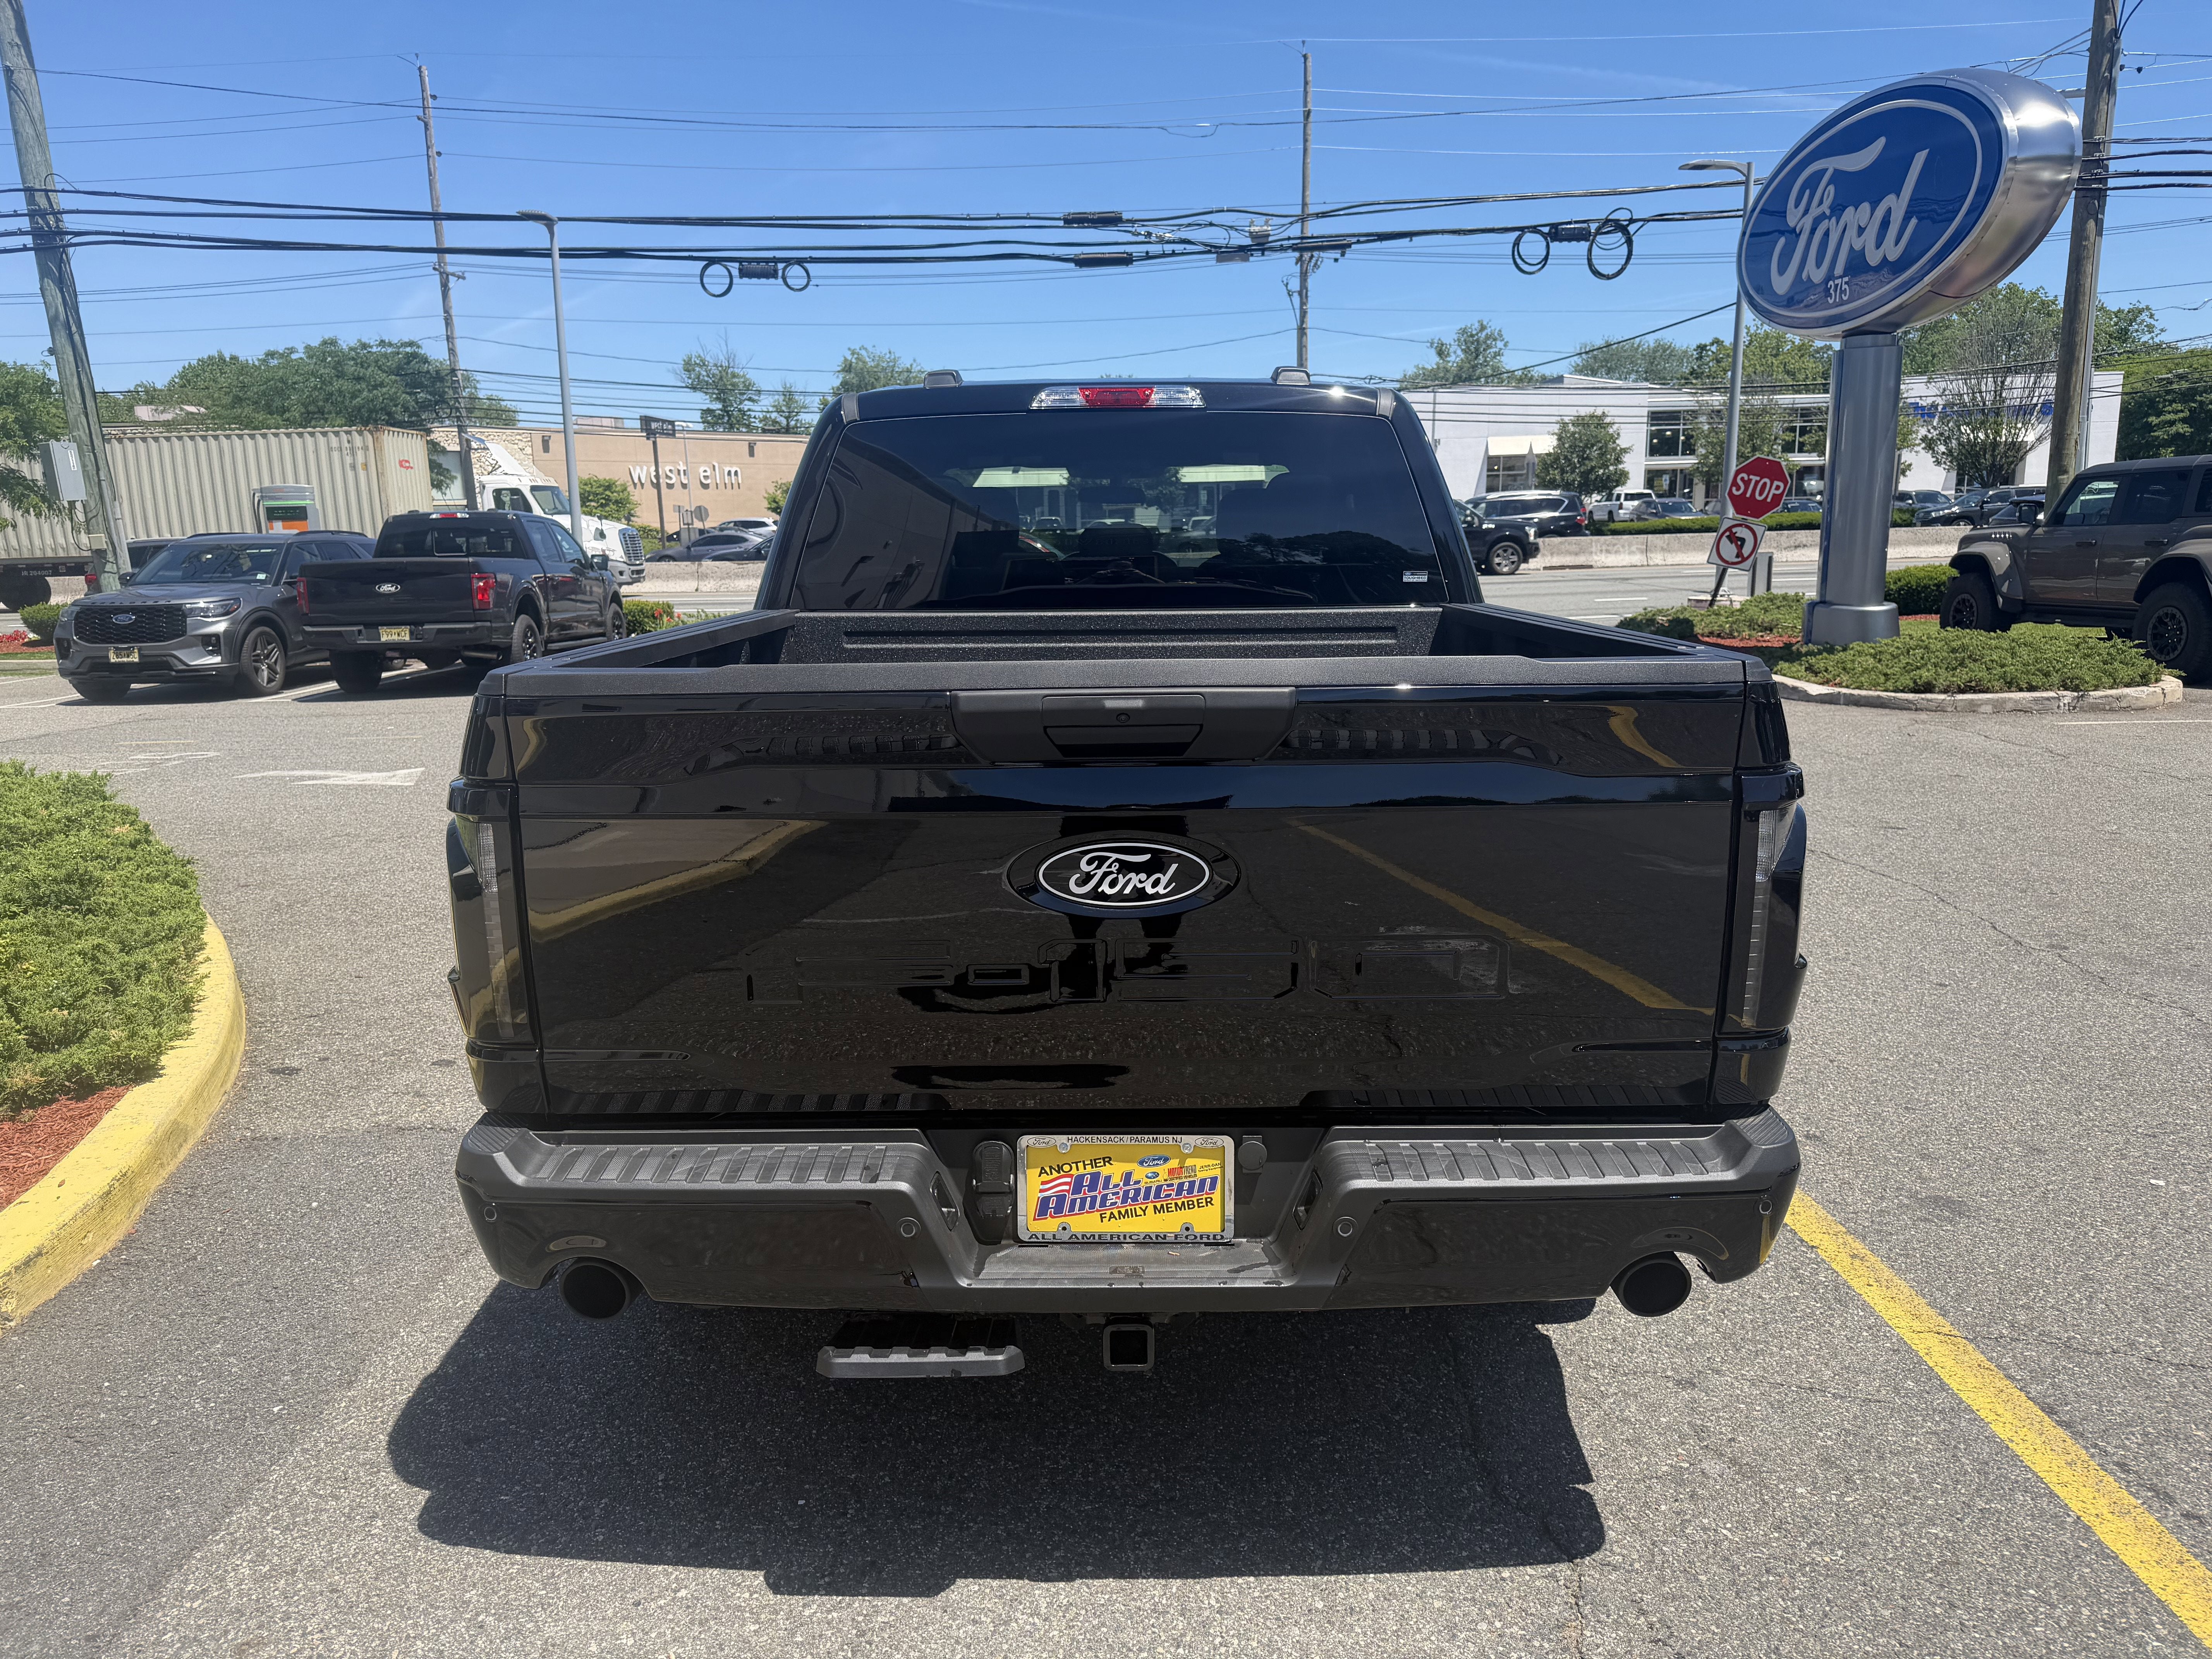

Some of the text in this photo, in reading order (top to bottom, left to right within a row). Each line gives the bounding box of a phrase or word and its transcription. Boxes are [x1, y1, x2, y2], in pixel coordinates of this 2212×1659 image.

[1771, 136, 1930, 295] Ford
[1827, 276, 1850, 304] 375
[628, 461, 742, 484] west elm
[1732, 472, 1784, 502] STOP
[1068, 852, 1179, 895] Ford
[1032, 1137, 1050, 1146] Ford
[1200, 1137, 1218, 1146] Ford
[1038, 1156, 1114, 1178] ANOTHER
[1143, 1156, 1164, 1166] Ford
[1069, 1170, 1144, 1197] ALL
[1099, 1197, 1215, 1223] FAMILY MEMBER
